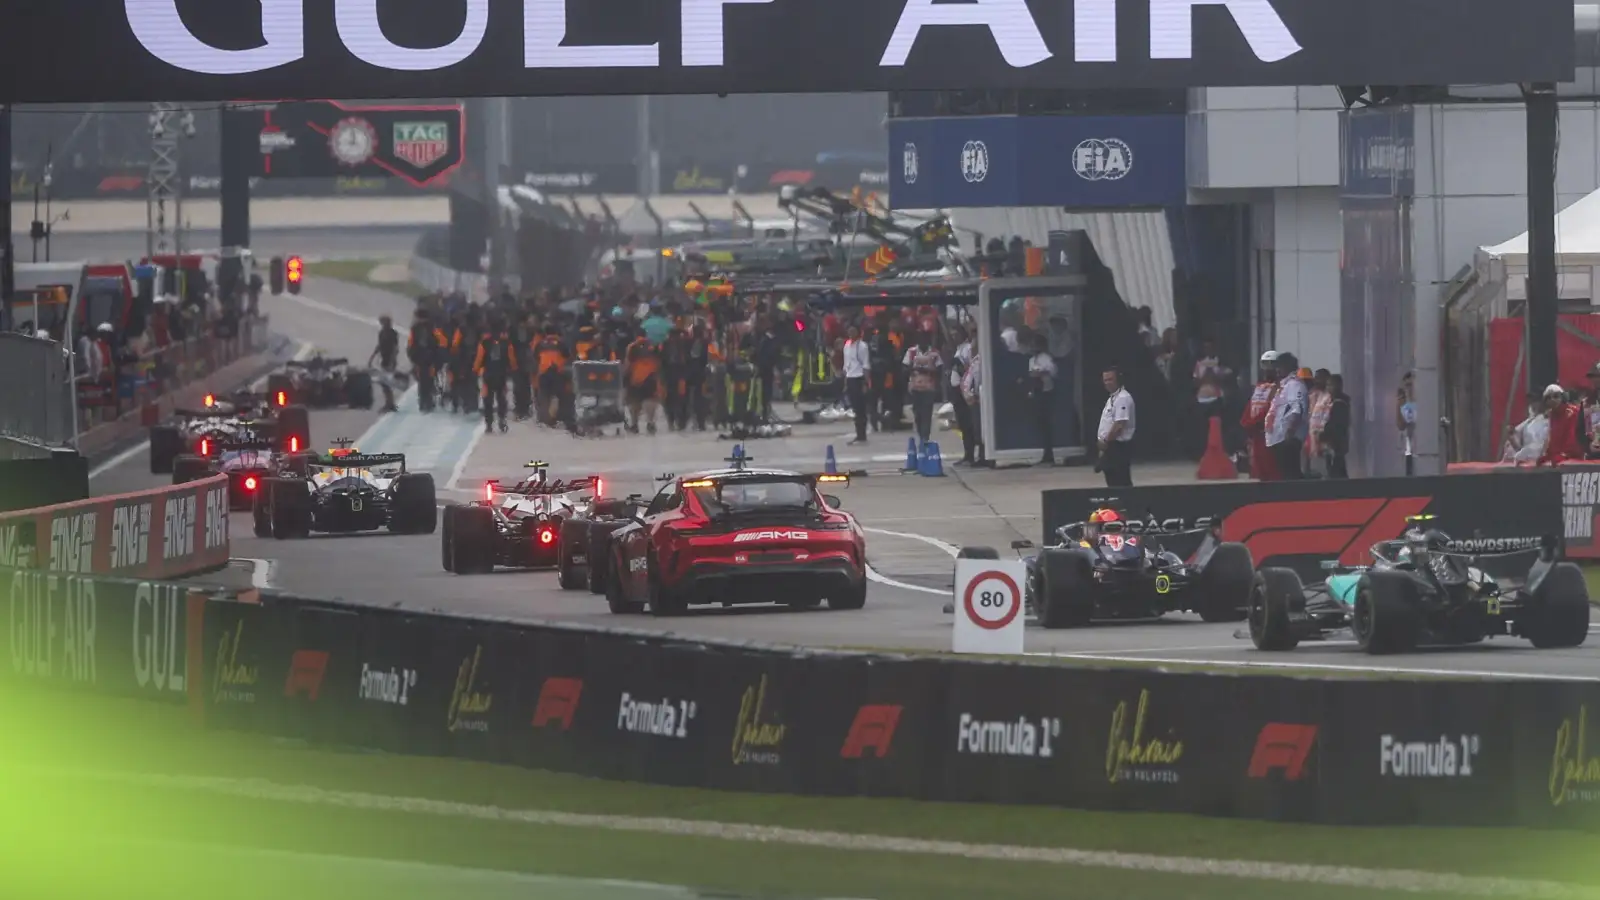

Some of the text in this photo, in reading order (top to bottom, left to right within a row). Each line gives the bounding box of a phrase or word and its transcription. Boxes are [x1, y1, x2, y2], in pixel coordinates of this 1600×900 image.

[397, 124, 443, 140] TAG
[338, 453, 364, 461] Cash
[758, 531, 808, 540] AMG
[1446, 537, 1543, 552] CROWDSTRIKE
[981, 591, 1004, 607] 80
[62, 574, 96, 686] AIR
[133, 582, 188, 691] GUL
[359, 663, 398, 703] Formula
[618, 692, 675, 737] Formula
[957, 712, 1036, 757] Formula
[1380, 734, 1456, 776] Formula
